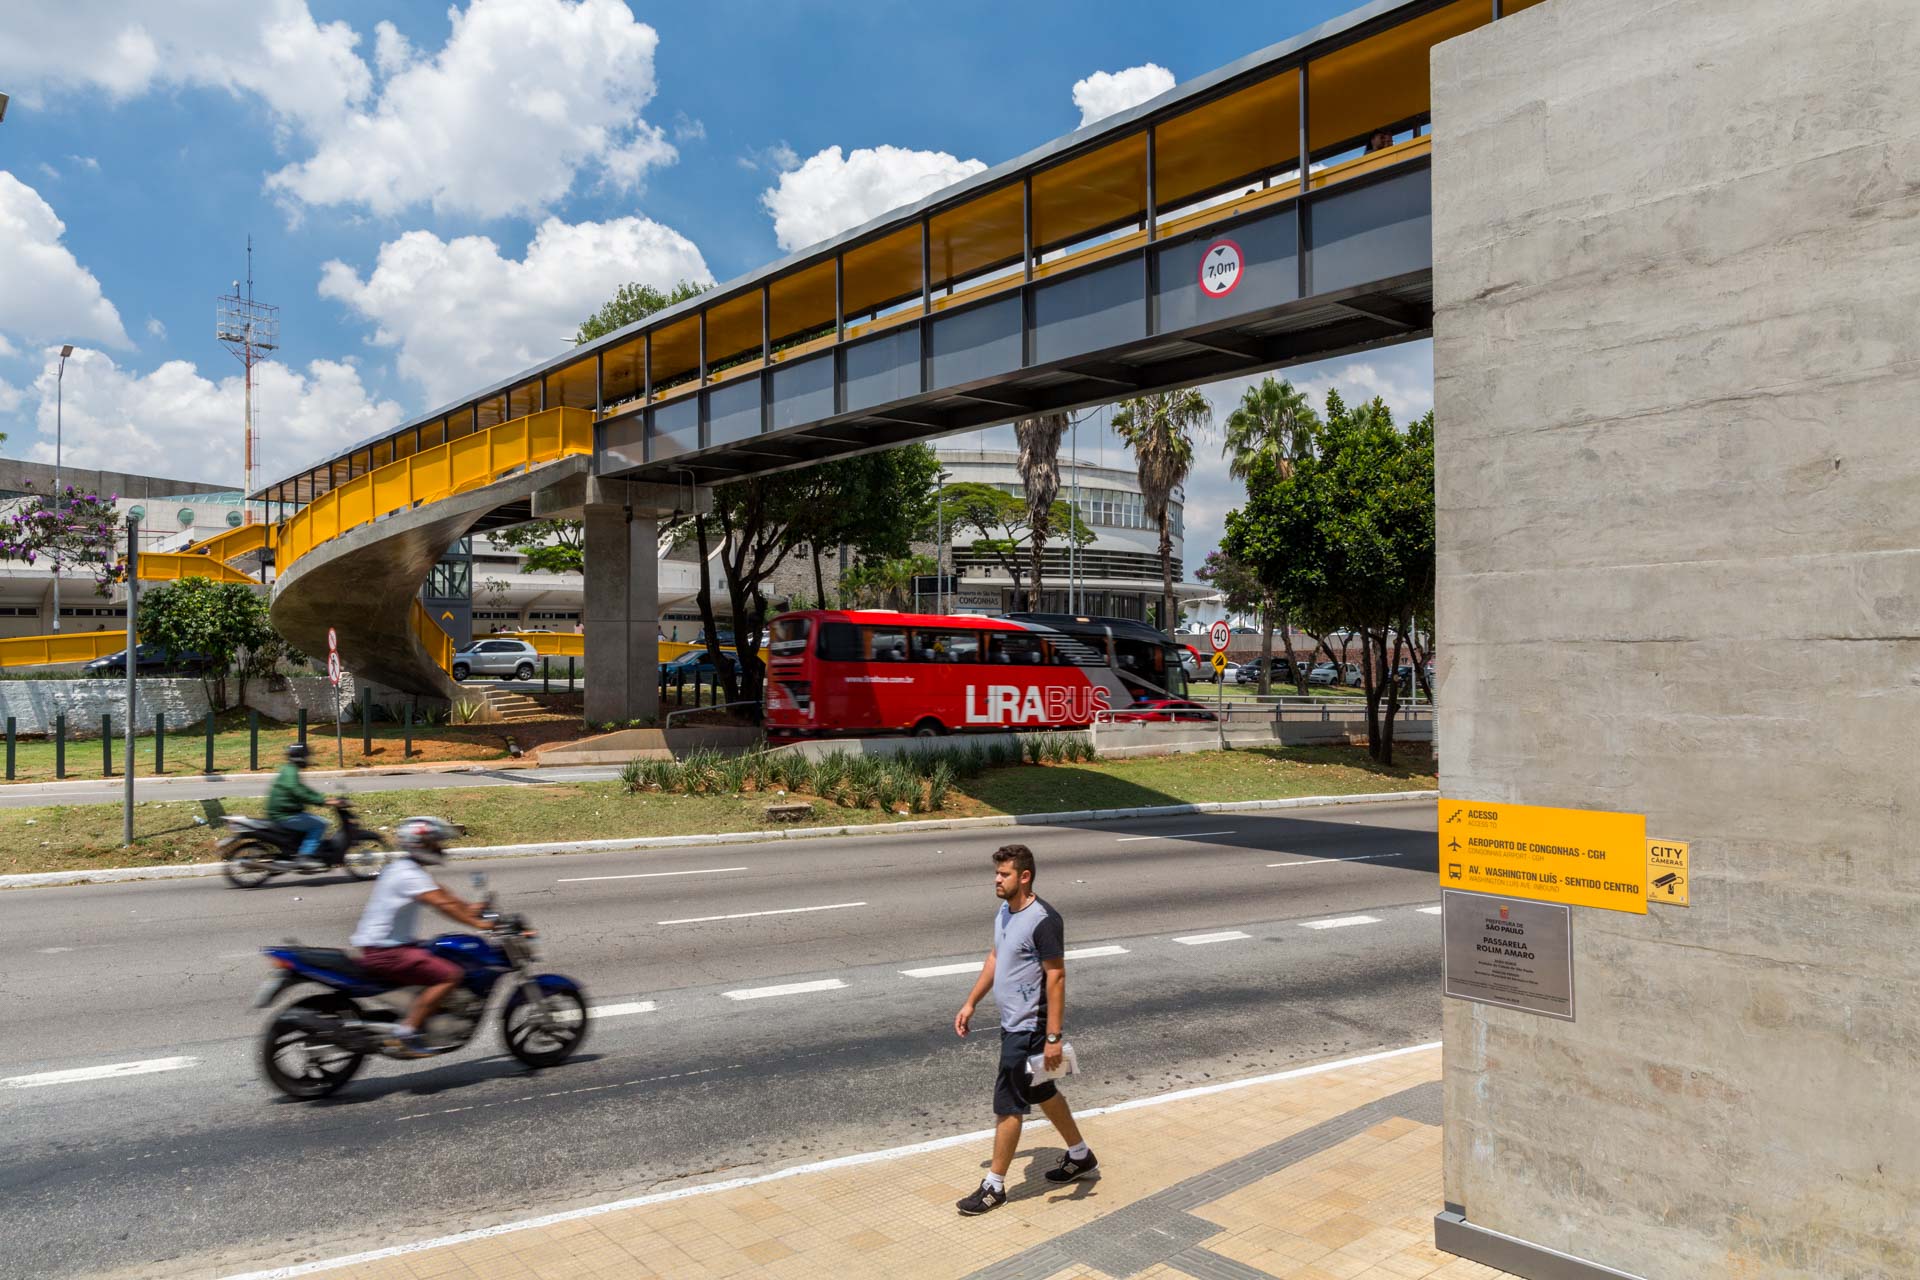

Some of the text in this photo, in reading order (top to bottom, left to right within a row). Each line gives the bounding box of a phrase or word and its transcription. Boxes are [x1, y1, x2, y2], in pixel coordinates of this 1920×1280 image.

[1208, 262, 1236, 279] 7,0m
[959, 596, 999, 605] CONGONHAS
[1214, 629, 1227, 642] 40
[1468, 810, 1498, 820] ACESSO
[1468, 838, 1515, 850] AEROPORTO
[1517, 842, 1527, 851] DE
[1529, 843, 1580, 857] CONGONHAS
[1587, 849, 1606, 860] CGH
[1651, 846, 1683, 859] CITY
[1469, 865, 1480, 875] AV.
[1485, 867, 1537, 881] WASHINGTON
[1539, 872, 1558, 884] LUÍS
[1565, 876, 1601, 889] SENTIDO
[1603, 881, 1639, 894] CENTRO
[1485, 918, 1516, 928] PREFEITURA
[1485, 923, 1524, 935] SÃO PAULO
[1483, 936, 1528, 950] PASSARELA
[1476, 944, 1535, 960] ROLIM AMARO
